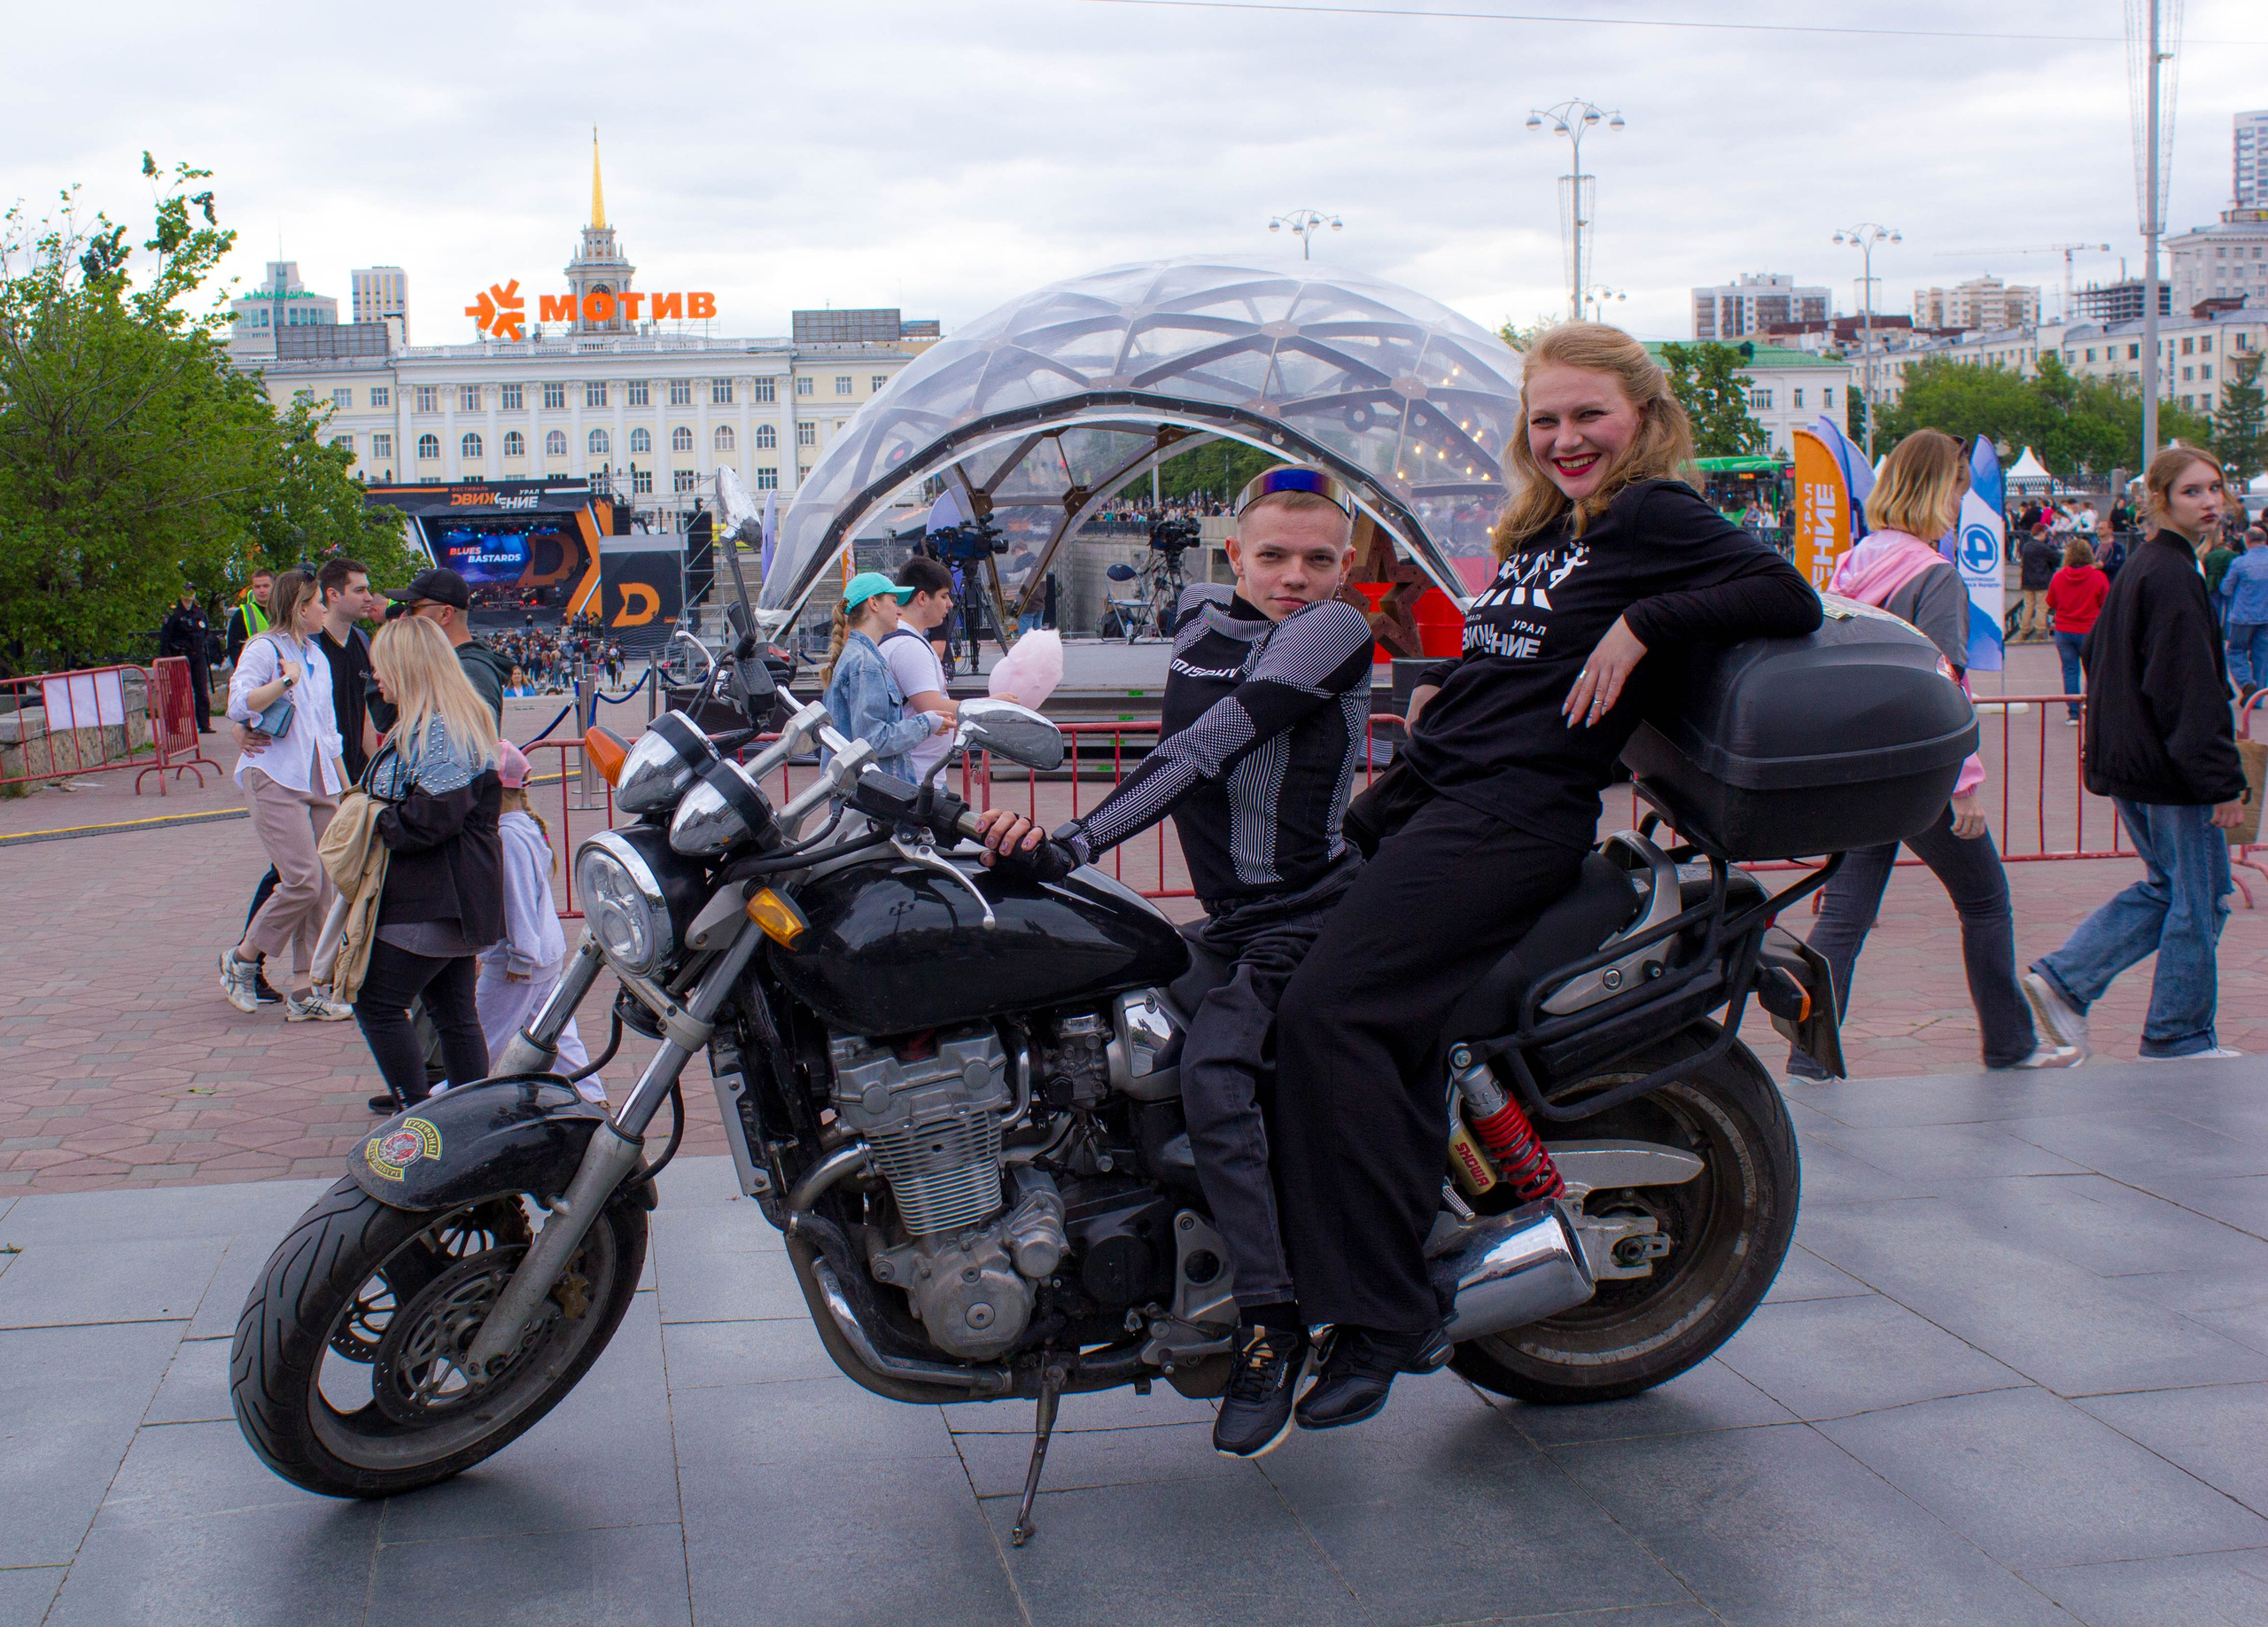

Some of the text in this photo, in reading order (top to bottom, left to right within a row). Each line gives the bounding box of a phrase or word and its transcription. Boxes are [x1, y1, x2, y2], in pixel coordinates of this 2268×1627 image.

[540, 292, 717, 322] МОТИВ
[1804, 483, 1813, 534] УРАЛ
[449, 547, 482, 556] BLUES
[1811, 484, 1836, 591] ЕНИЕ
[468, 554, 521, 563] BASTARDS
[1511, 619, 1547, 635] УРАЛ
[408, 1120, 438, 1153] ГРИФОНЫ
[1454, 1142, 1490, 1187] SHOWA
